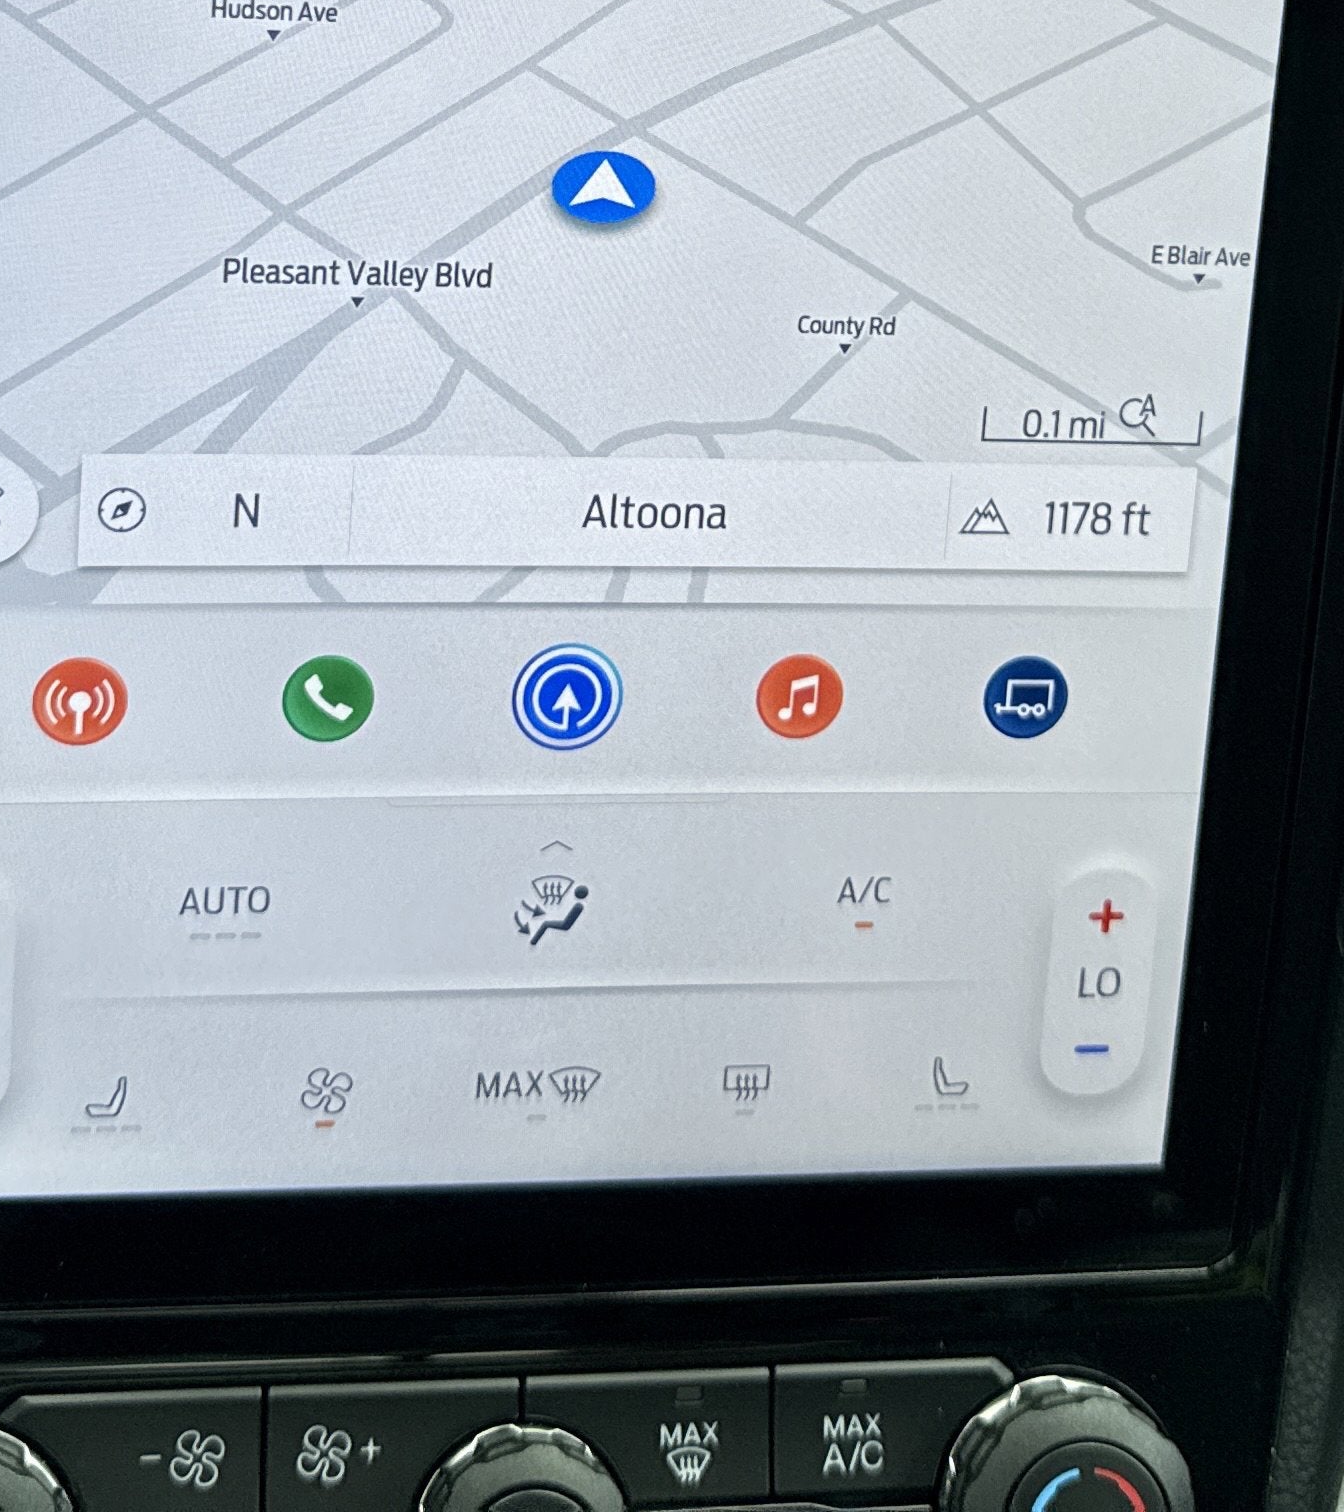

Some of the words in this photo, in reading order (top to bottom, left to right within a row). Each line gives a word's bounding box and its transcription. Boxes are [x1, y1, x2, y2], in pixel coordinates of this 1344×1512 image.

[297, 1, 338, 23] Ave
[1151, 244, 1164, 265] E
[1167, 244, 1212, 266] Blair
[1214, 247, 1251, 267] Ave
[223, 256, 341, 286] Pleasant
[347, 259, 429, 293] Valley
[435, 261, 493, 289] Blvd
[797, 314, 865, 340] County
[869, 316, 897, 336] Rd
[1022, 408, 1060, 438] 0.1
[1068, 410, 1106, 439] mi
[233, 493, 260, 528] N
[581, 493, 727, 530] Altoona
[1045, 501, 1112, 536] 1178
[1122, 501, 1152, 537] ft
[178, 885, 271, 916] AUTO
[837, 876, 892, 904] A/C
[1078, 967, 1121, 999] LO
[475, 1070, 544, 1100] MAX
[660, 1421, 719, 1448] MAX
[823, 1413, 881, 1439] MAX
[822, 1440, 883, 1473] A/C
